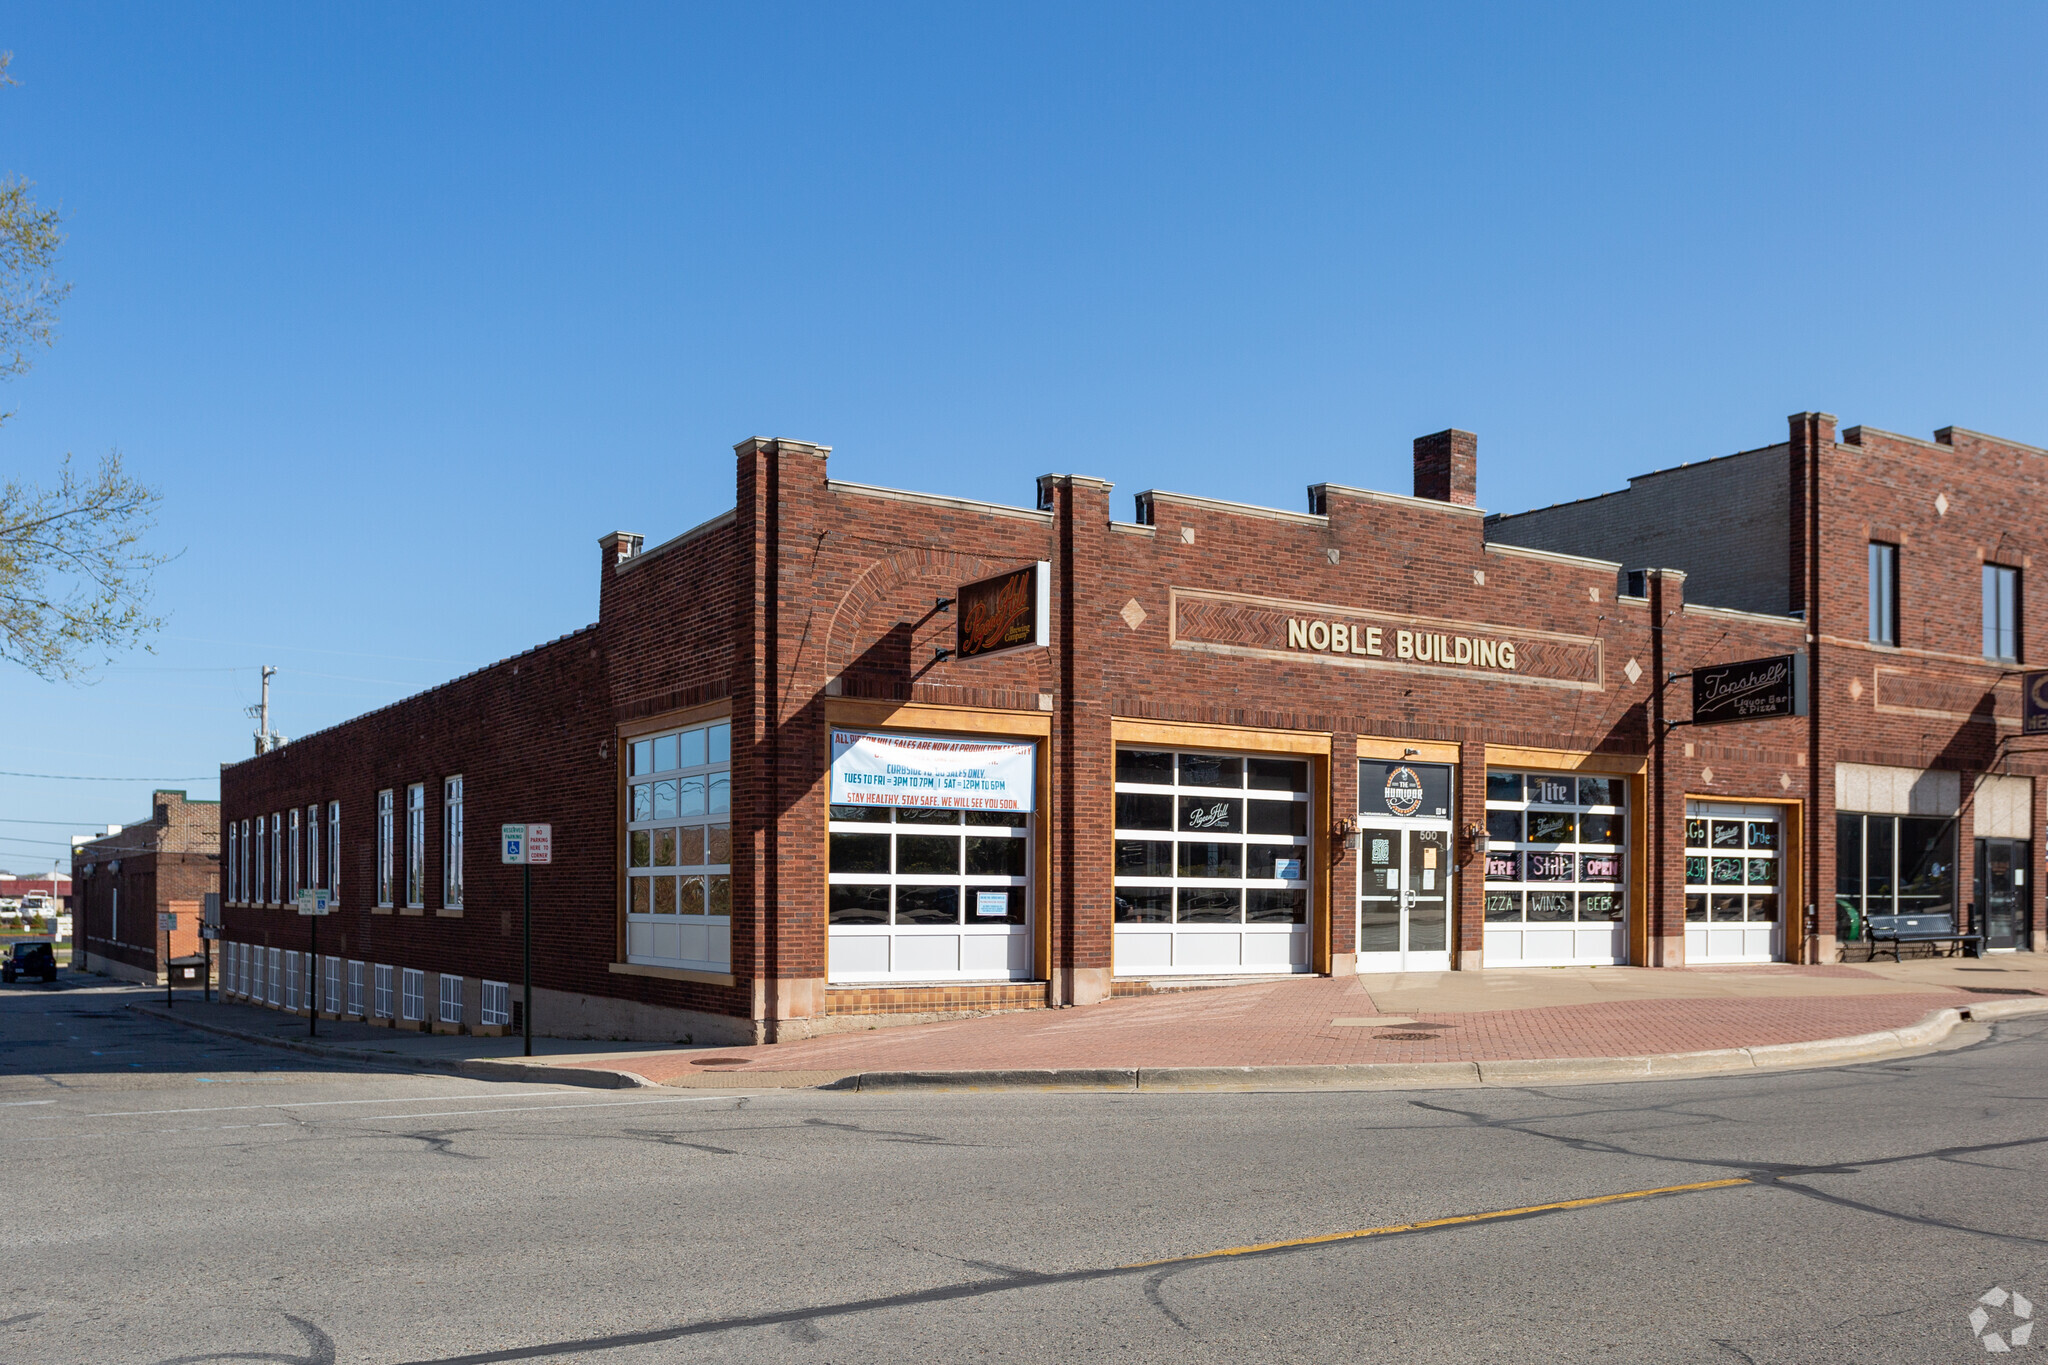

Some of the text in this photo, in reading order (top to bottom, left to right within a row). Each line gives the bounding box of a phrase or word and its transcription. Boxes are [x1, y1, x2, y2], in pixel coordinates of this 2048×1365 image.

[1288, 618, 1517, 670] NOBLE BUILDING
[1704, 662, 1788, 699] Topshelf
[1734, 698, 1767, 708] Liquor
[1749, 704, 1777, 714] Pizza
[835, 733, 849, 744] ALL
[894, 739, 916, 750] SALES
[916, 741, 933, 751] ARE
[932, 742, 950, 752] NOW
[949, 743, 960, 752] AT
[844, 773, 862, 784] TUES
[863, 774, 873, 785] TO
[874, 775, 886, 786] FRI
[892, 776, 908, 787] 3PM
[909, 777, 918, 788] TO
[919, 778, 934, 788] 7PM
[943, 779, 956, 789] SAT
[962, 779, 980, 790] 12PM
[981, 780, 990, 791] TO
[990, 780, 1006, 791] 6PM
[967, 768, 986, 779] ONLY.
[847, 792, 1020, 810] STAY HEALTHY. STAY SAFE. WE WILL SEE YOU SOON.
[1384, 787, 1423, 800] HUMIDOR
[1540, 781, 1567, 804] Lite
[1420, 831, 1438, 840] 500
[1533, 856, 1565, 876] Still
[1587, 860, 1618, 876] OPEN
[1532, 896, 1567, 912] WINGS
[1587, 896, 1612, 911] BEER
